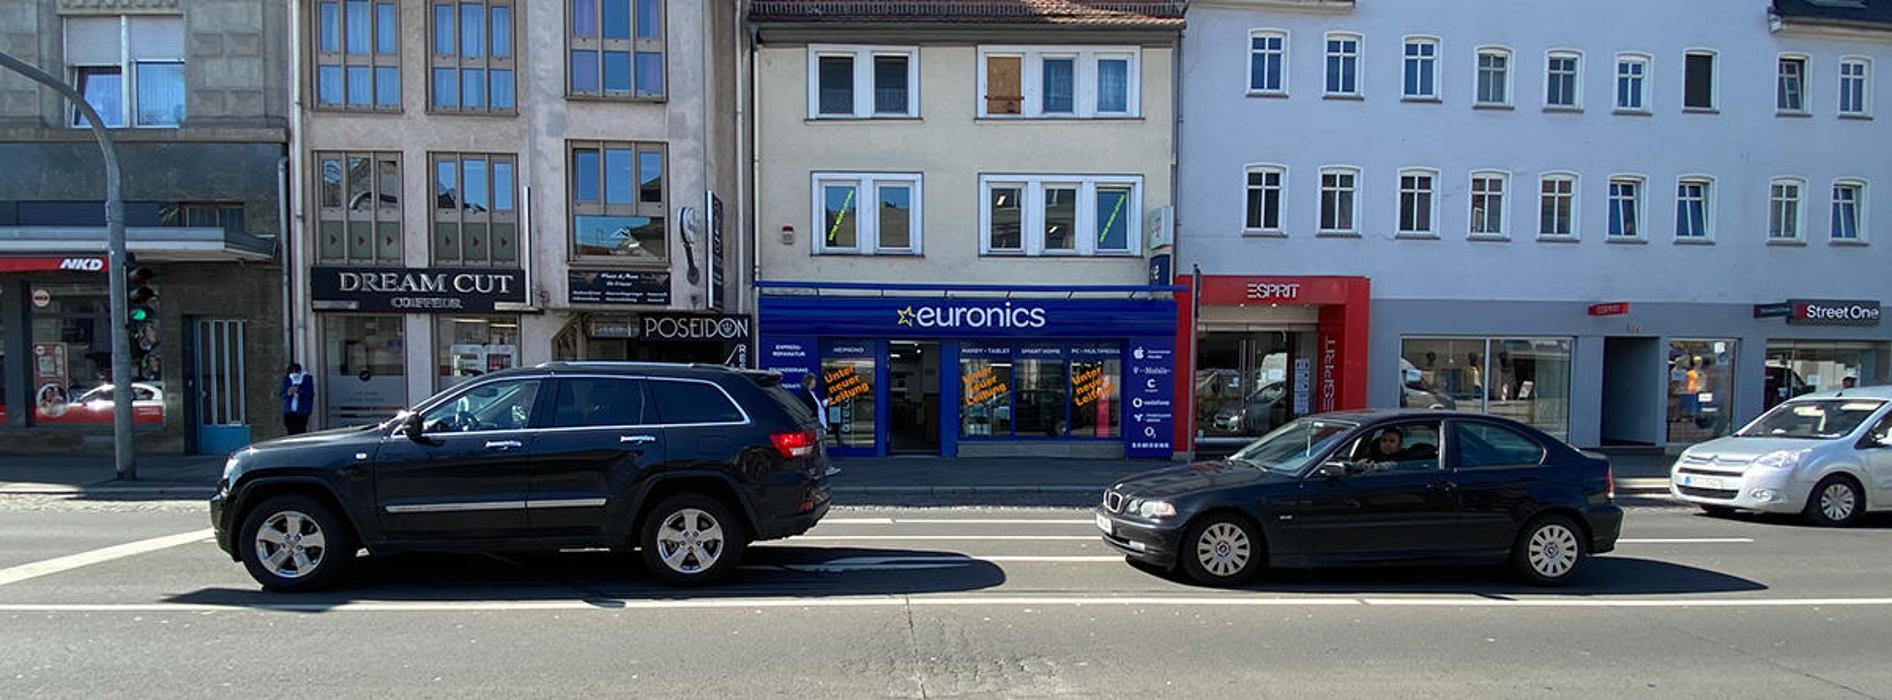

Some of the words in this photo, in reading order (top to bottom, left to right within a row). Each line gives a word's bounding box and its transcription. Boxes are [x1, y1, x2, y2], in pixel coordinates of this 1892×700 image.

[60, 259, 103, 270] NKD
[339, 272, 447, 292] DREAM
[453, 274, 514, 293] CUT
[1247, 283, 1300, 298] ESPRIT
[391, 297, 463, 308] COIFFEUR
[916, 302, 1046, 328] euronics
[1807, 305, 1849, 318] Street
[1850, 306, 1879, 319] One
[644, 317, 748, 338] POSEIDON
[824, 366, 853, 382] Unter
[1072, 367, 1101, 385] Unter
[828, 375, 860, 393] neuer
[828, 382, 870, 405] Leitung
